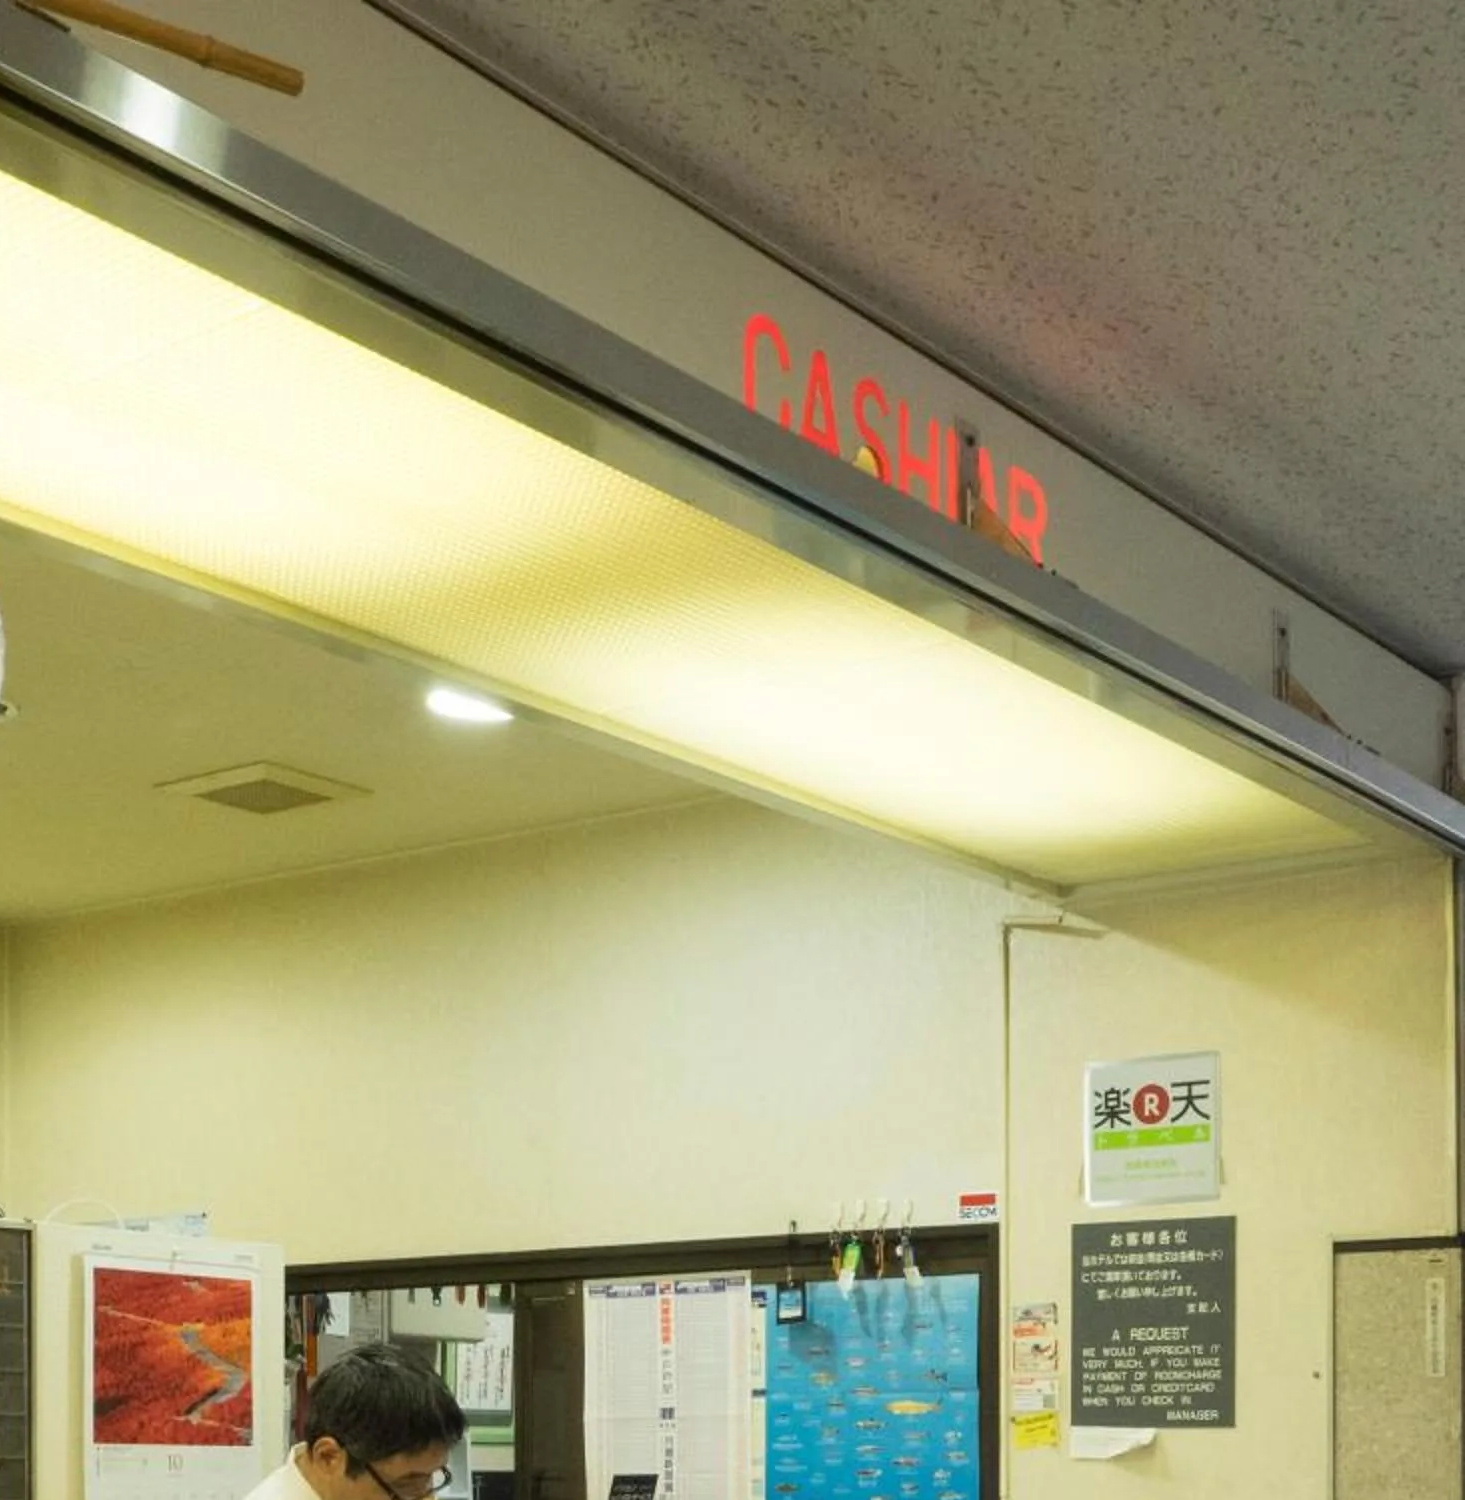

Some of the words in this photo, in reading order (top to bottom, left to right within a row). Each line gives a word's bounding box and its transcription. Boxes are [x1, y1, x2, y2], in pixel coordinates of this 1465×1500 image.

[1130, 1326, 1189, 1341] REQUEST
[1102, 1346, 1135, 1357] WOULD
[1083, 1359, 1108, 1369] VERY
[1167, 1358, 1187, 1367] YOU
[1115, 1396, 1135, 1406] YOU
[1167, 1410, 1219, 1421] MANAGER
